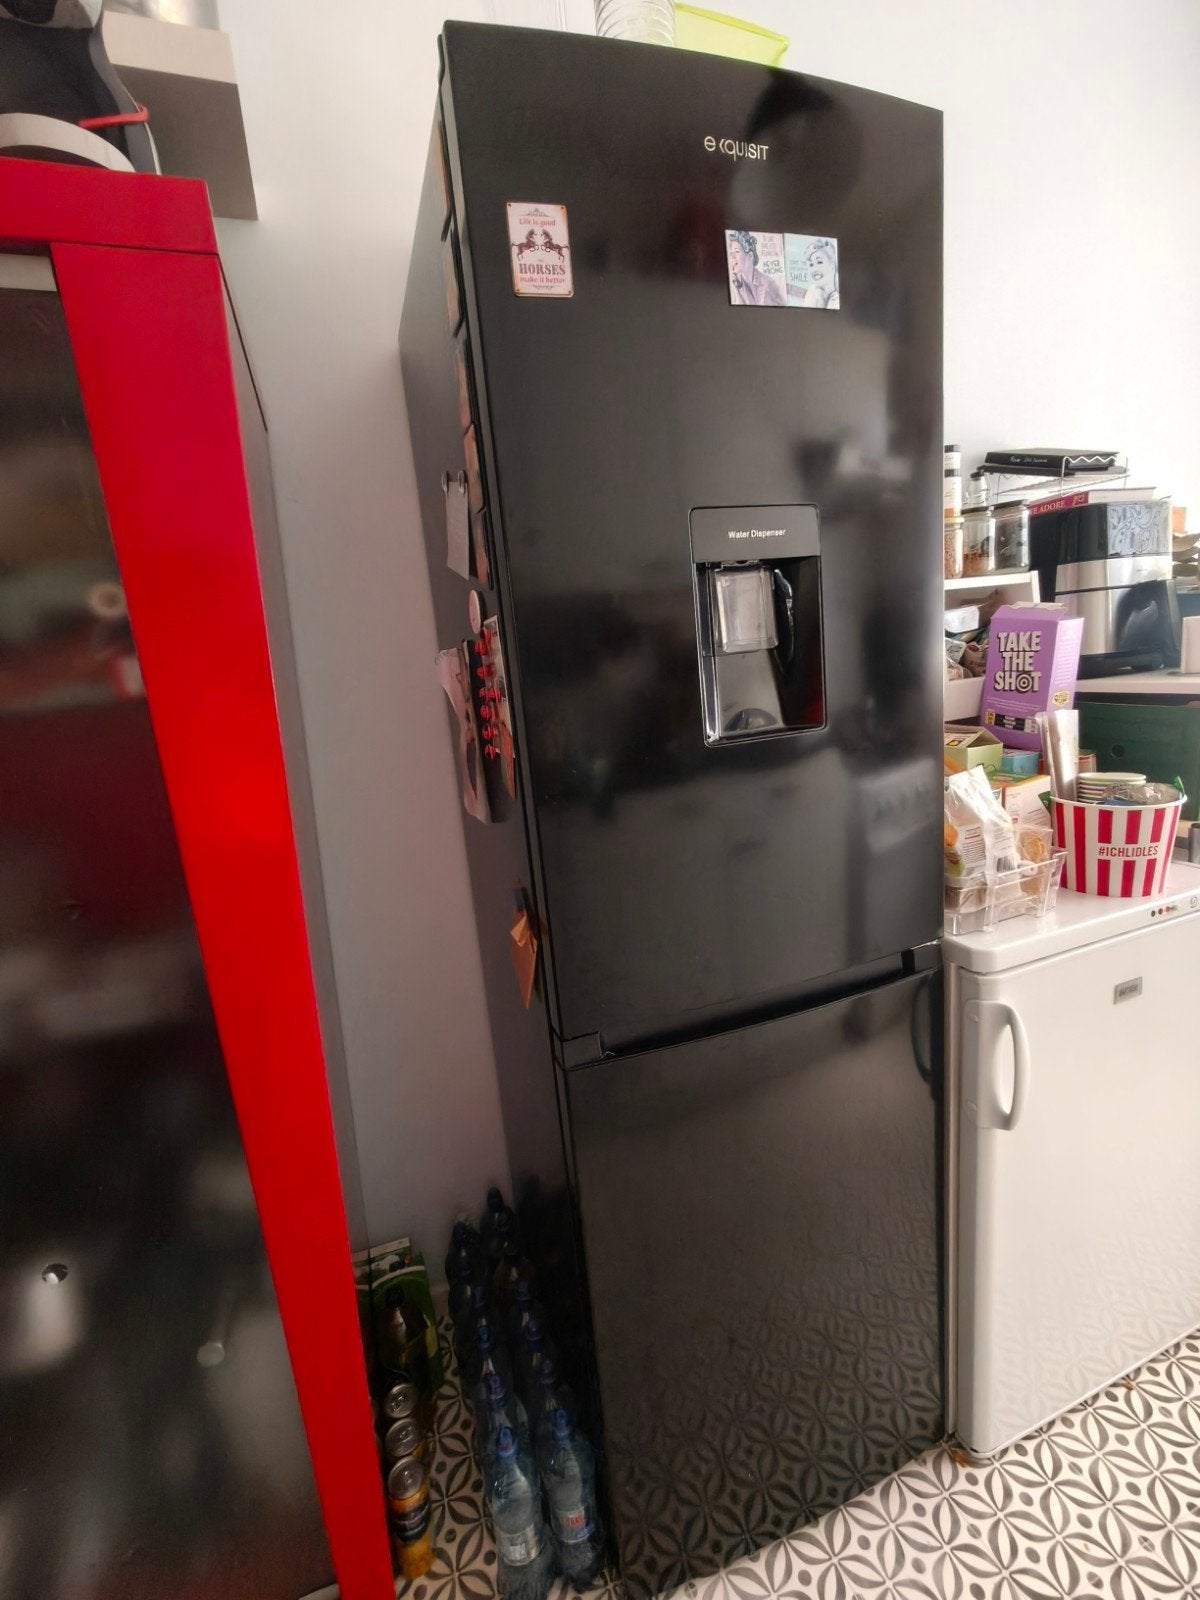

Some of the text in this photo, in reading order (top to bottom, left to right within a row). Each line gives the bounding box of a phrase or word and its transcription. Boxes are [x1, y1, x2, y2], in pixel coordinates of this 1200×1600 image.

[540, 219, 556, 228] good
[519, 263, 566, 275] HORSES
[1040, 500, 1065, 512] ADORE
[727, 529, 786, 538] Water Dispenser
[998, 631, 1042, 652] TAKE
[1002, 651, 1035, 672] THE
[994, 671, 1042, 693] SHOT
[1098, 846, 1159, 858] #ICHLIDLES
